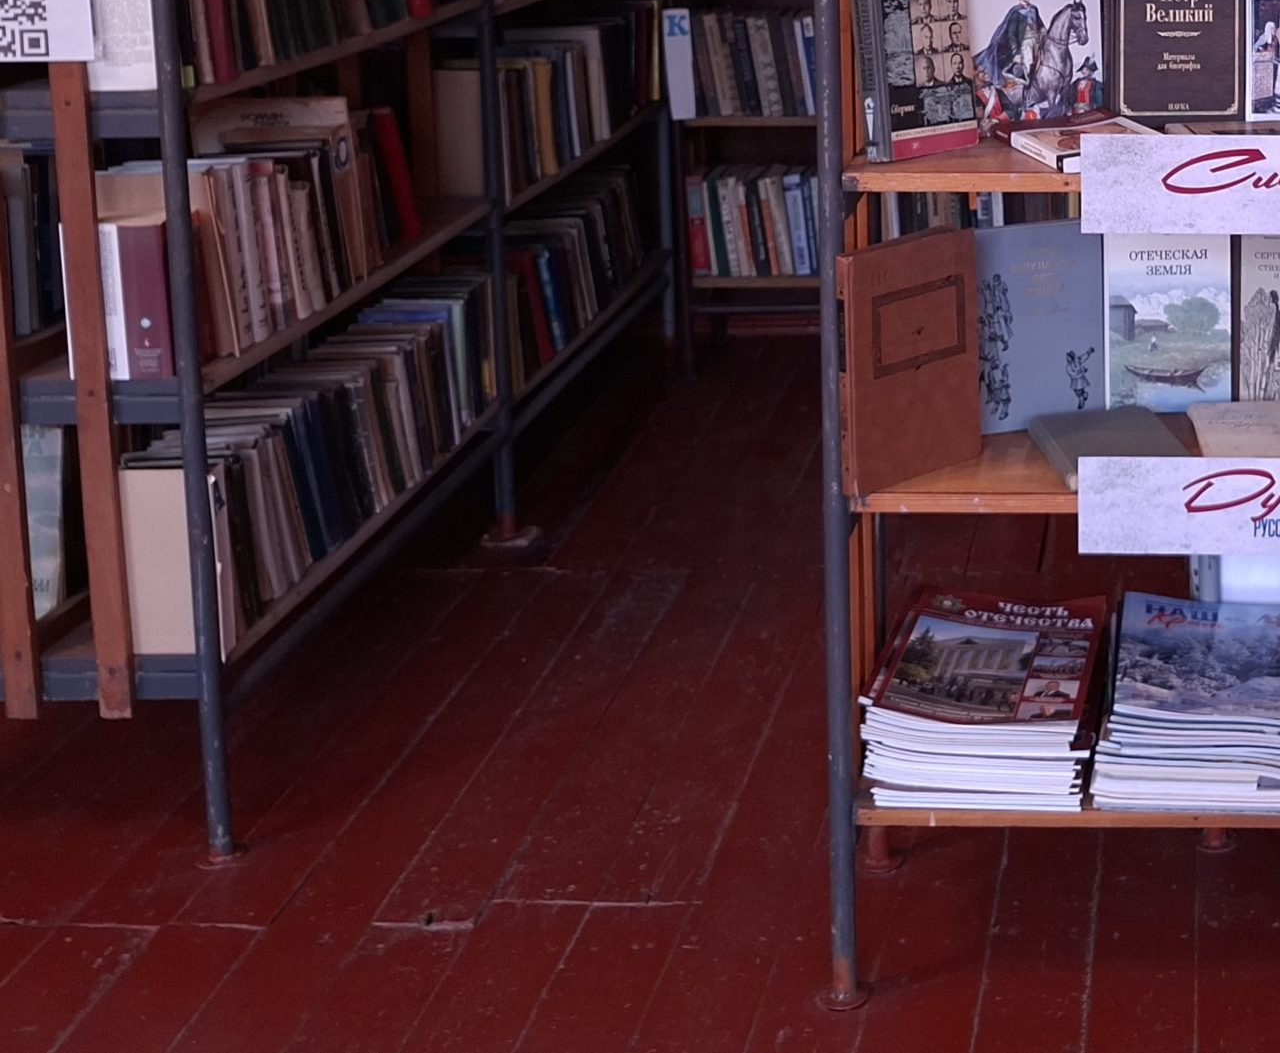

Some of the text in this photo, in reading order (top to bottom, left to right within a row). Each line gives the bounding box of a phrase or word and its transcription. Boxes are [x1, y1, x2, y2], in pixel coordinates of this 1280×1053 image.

[1145, 3, 1214, 23] Великий
[666, 14, 689, 37] К
[1128, 249, 1209, 261] ОТЕЧЕСКАЯ
[1145, 264, 1193, 276] ЗЕМЛЯ
